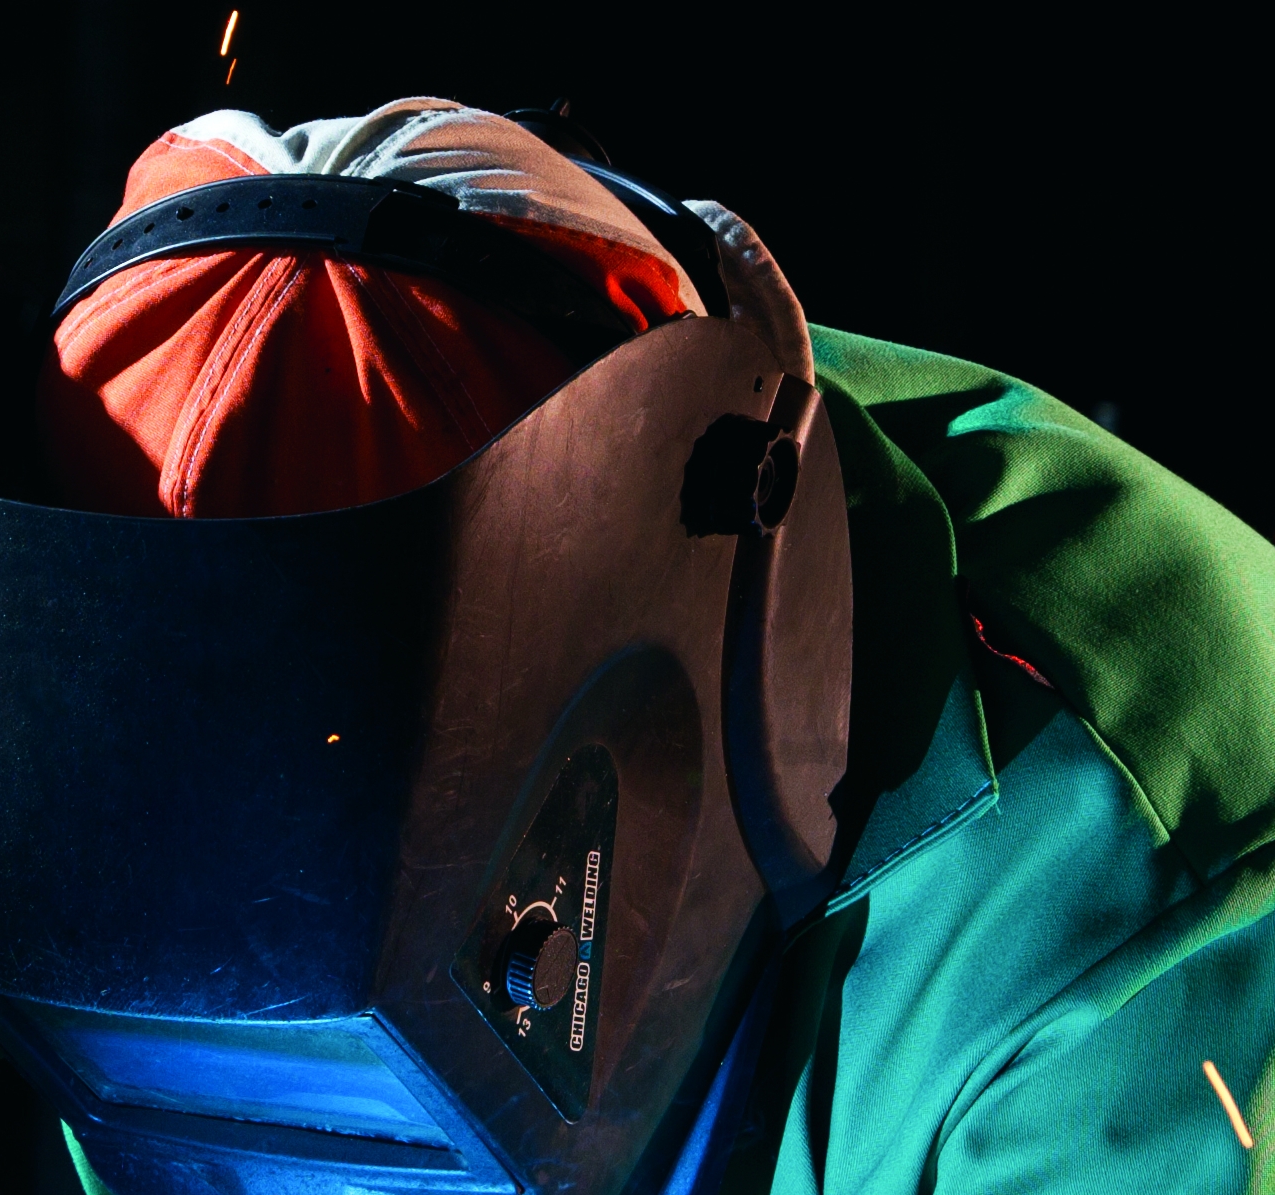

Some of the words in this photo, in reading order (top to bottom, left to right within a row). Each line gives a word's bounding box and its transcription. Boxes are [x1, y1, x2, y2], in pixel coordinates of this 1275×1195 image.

[555, 876, 567, 895] 11
[505, 894, 517, 915] 10
[570, 962, 590, 1051] CHICAGO
[580, 850, 601, 941] WELDING
[518, 1018, 531, 1037] 13
